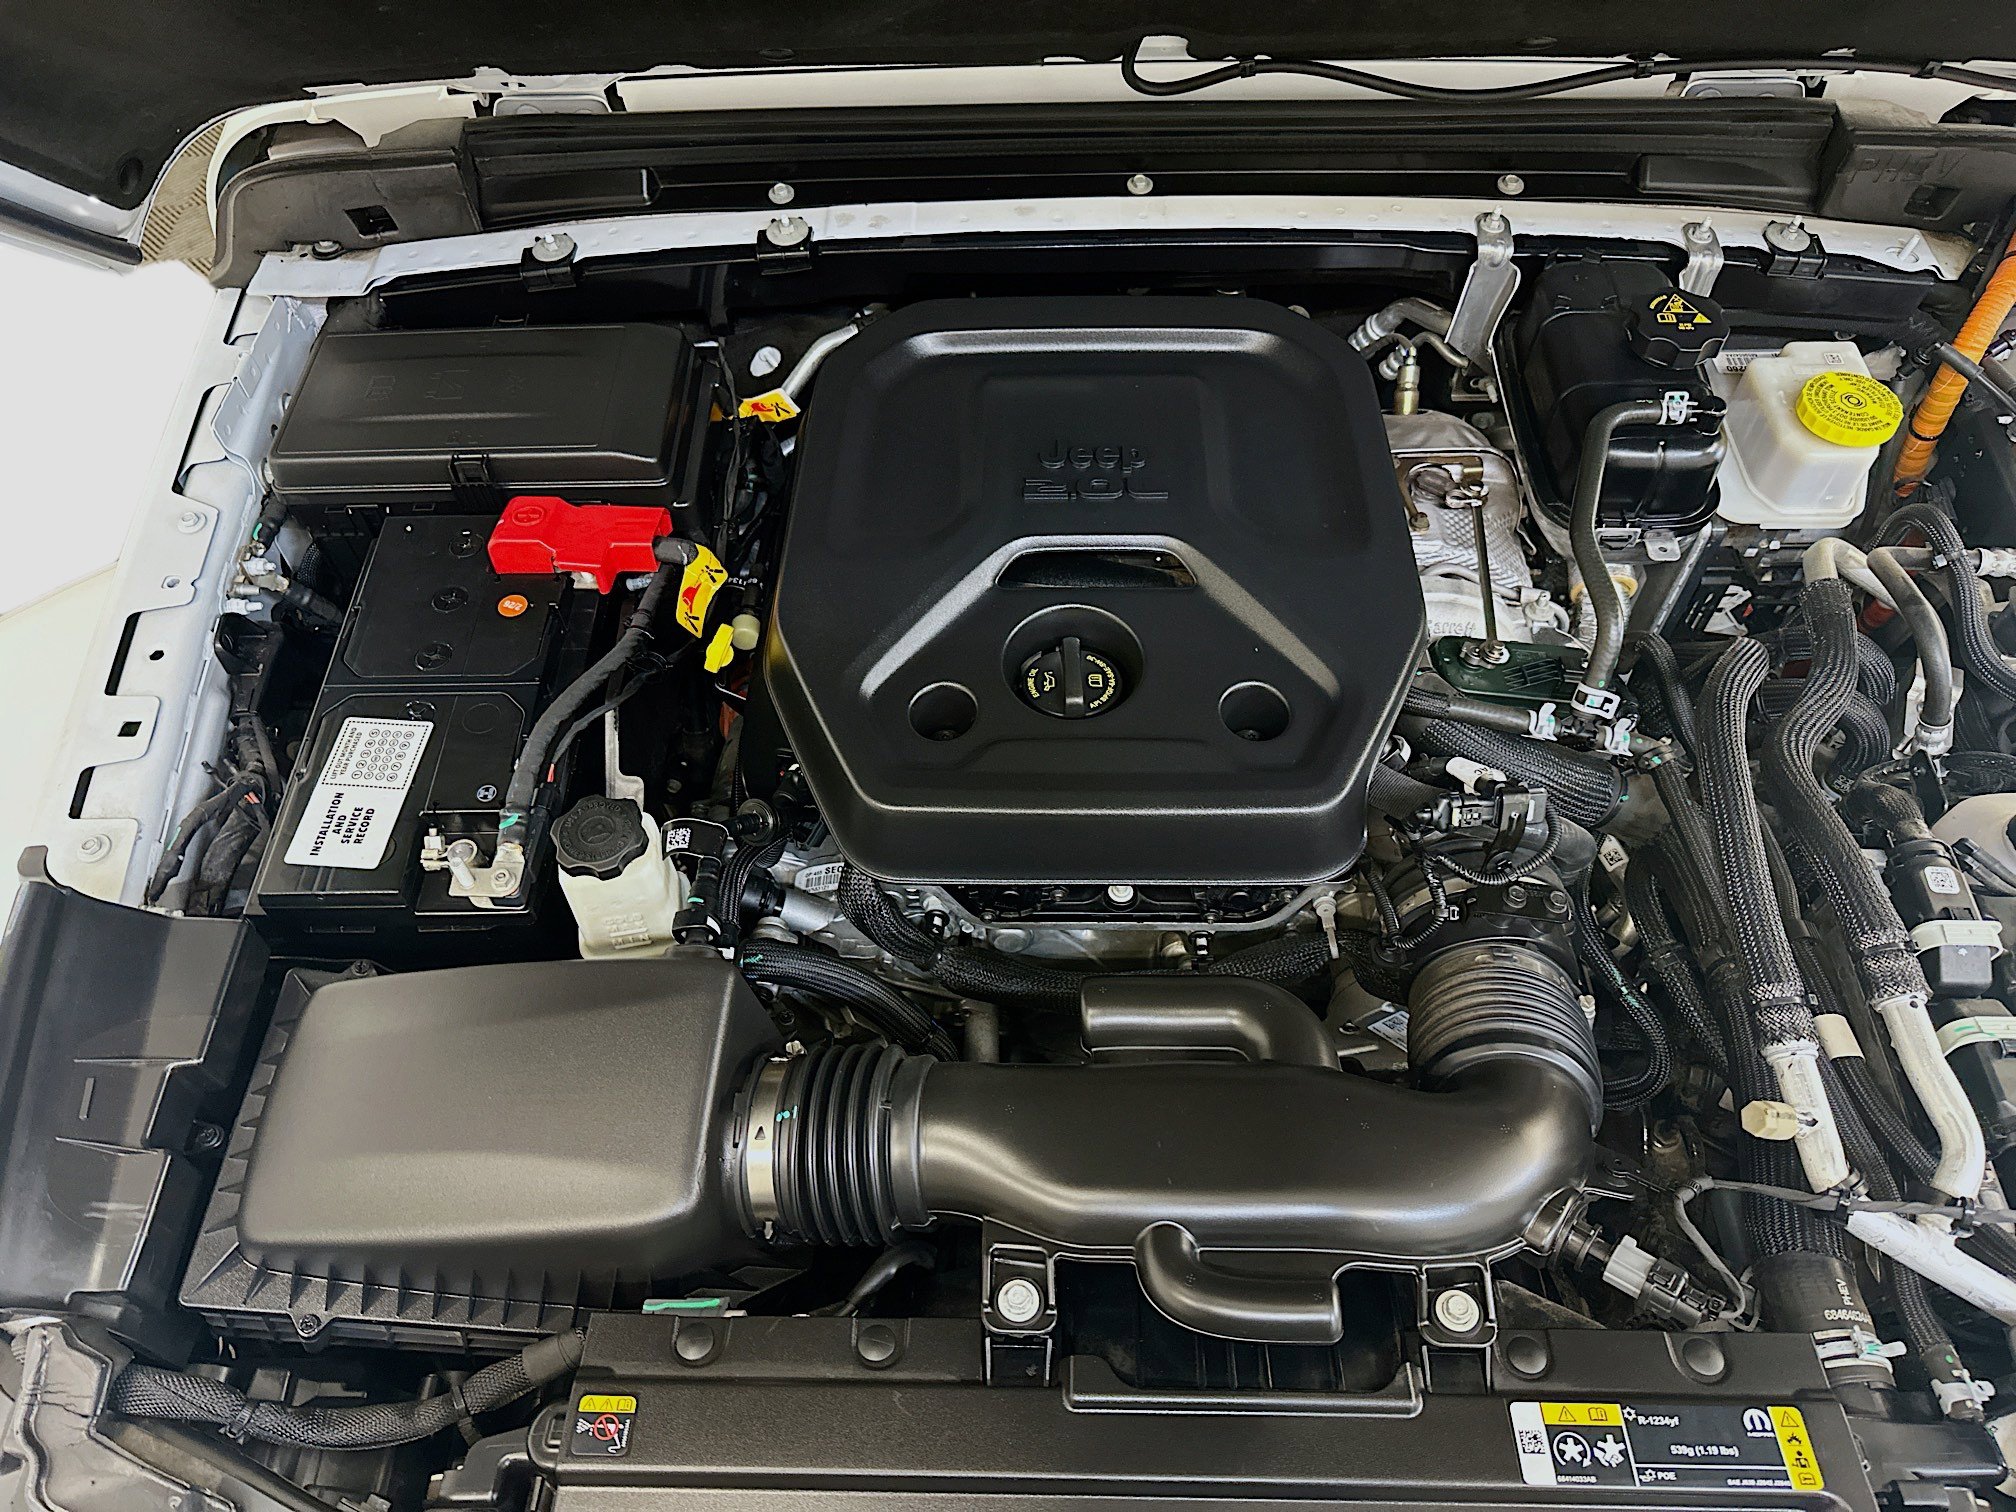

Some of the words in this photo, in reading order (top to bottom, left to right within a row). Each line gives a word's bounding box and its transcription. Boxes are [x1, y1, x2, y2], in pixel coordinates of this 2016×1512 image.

[1039, 440, 1146, 473] Jeep
[1023, 478, 1168, 500] 2.0L
[1029, 668, 1038, 676] OIL
[1028, 678, 1040, 698] ENGINE
[1090, 700, 1102, 708] API
[334, 758, 343, 768] OUT
[339, 739, 352, 757] MONTH
[347, 727, 357, 738] AND
[340, 762, 349, 775] YEAR
[346, 732, 362, 761] PURCHASED
[310, 792, 344, 856] INSTALLATION
[332, 815, 347, 834] AND
[341, 807, 363, 844] SERVICE
[354, 808, 375, 844] RECORD
[1836, 1279, 1854, 1306] PHEV
[1637, 1416, 1679, 1427] R-1234yf
[1657, 1471, 1677, 1481] POE
